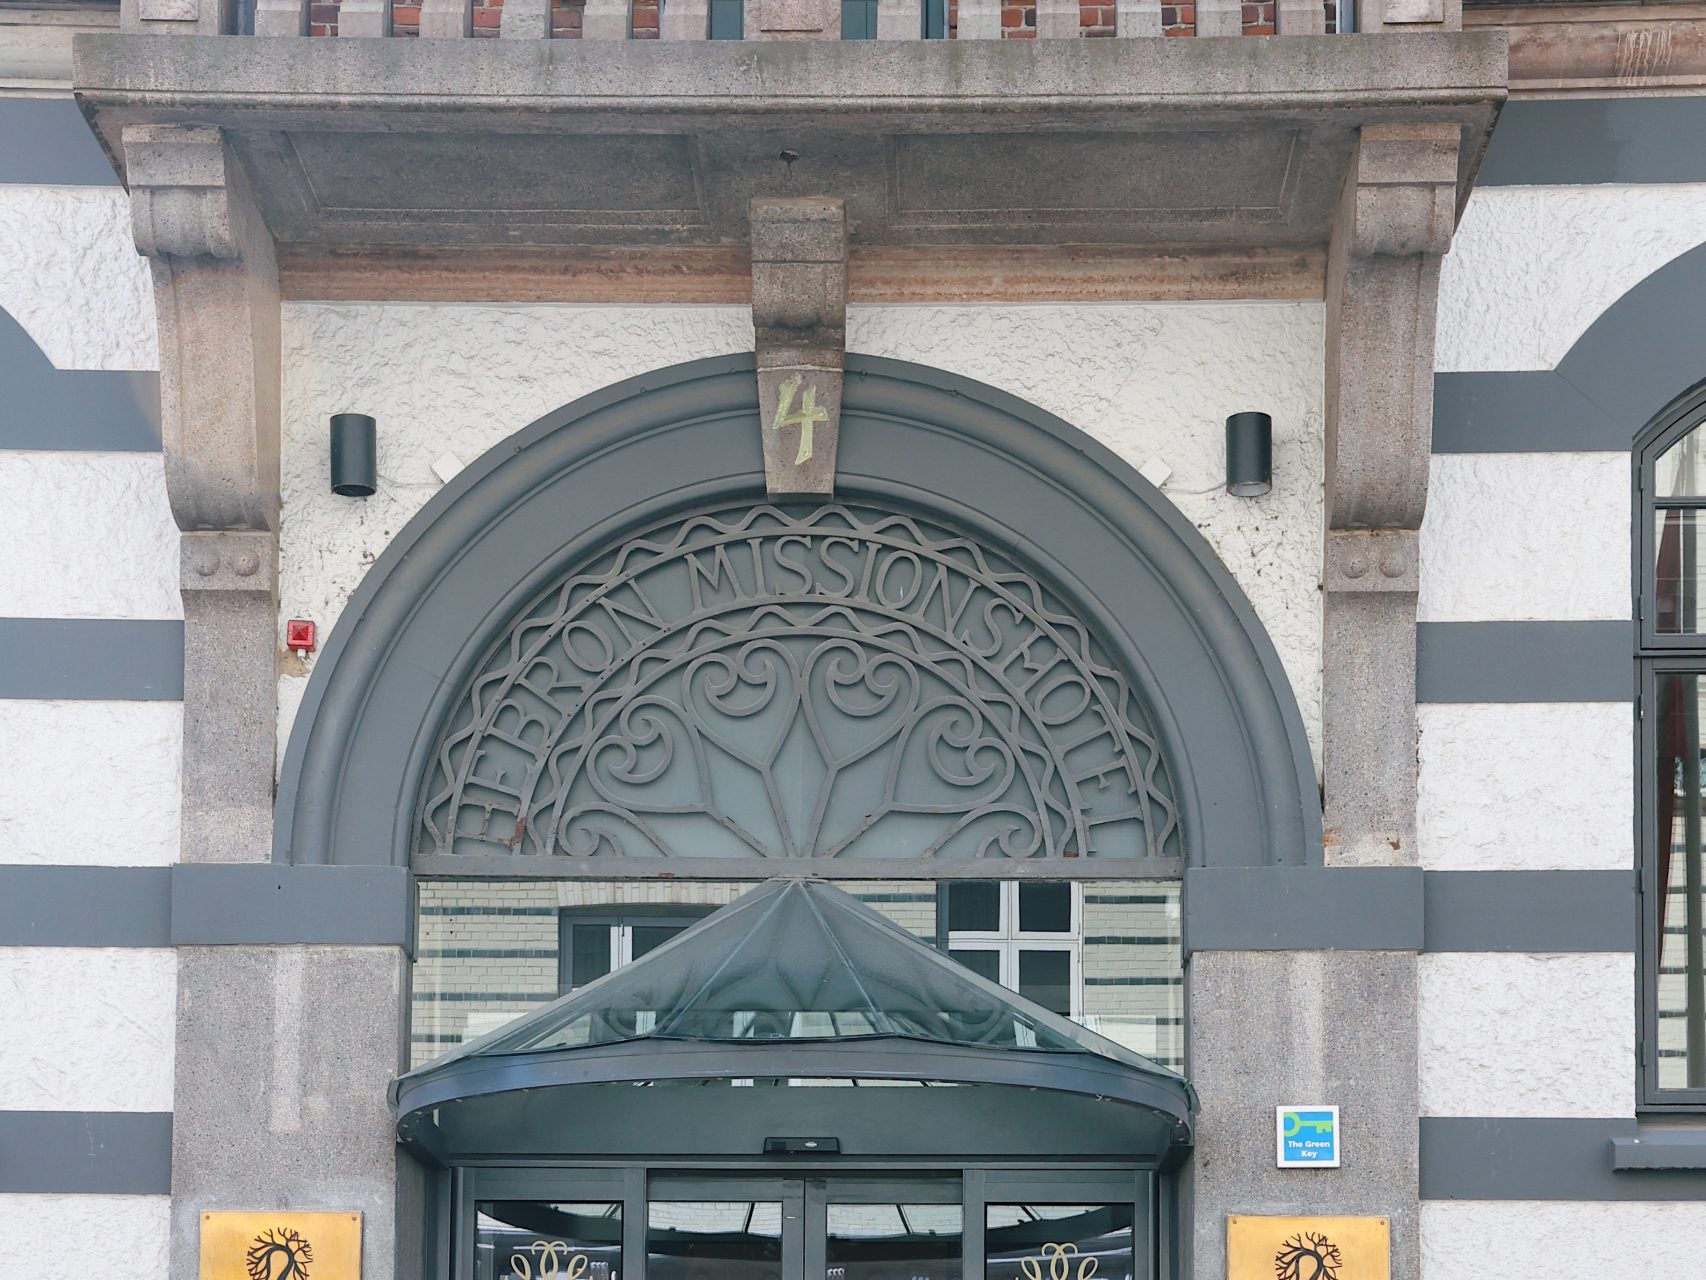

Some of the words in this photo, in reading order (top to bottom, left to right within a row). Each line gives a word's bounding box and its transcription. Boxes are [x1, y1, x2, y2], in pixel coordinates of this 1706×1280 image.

[771, 373, 830, 466] 4
[454, 578, 670, 851] HEBRON
[1288, 1140, 1303, 1148] The
[1305, 1140, 1330, 1148] Green
[1301, 1150, 1318, 1159] Key
